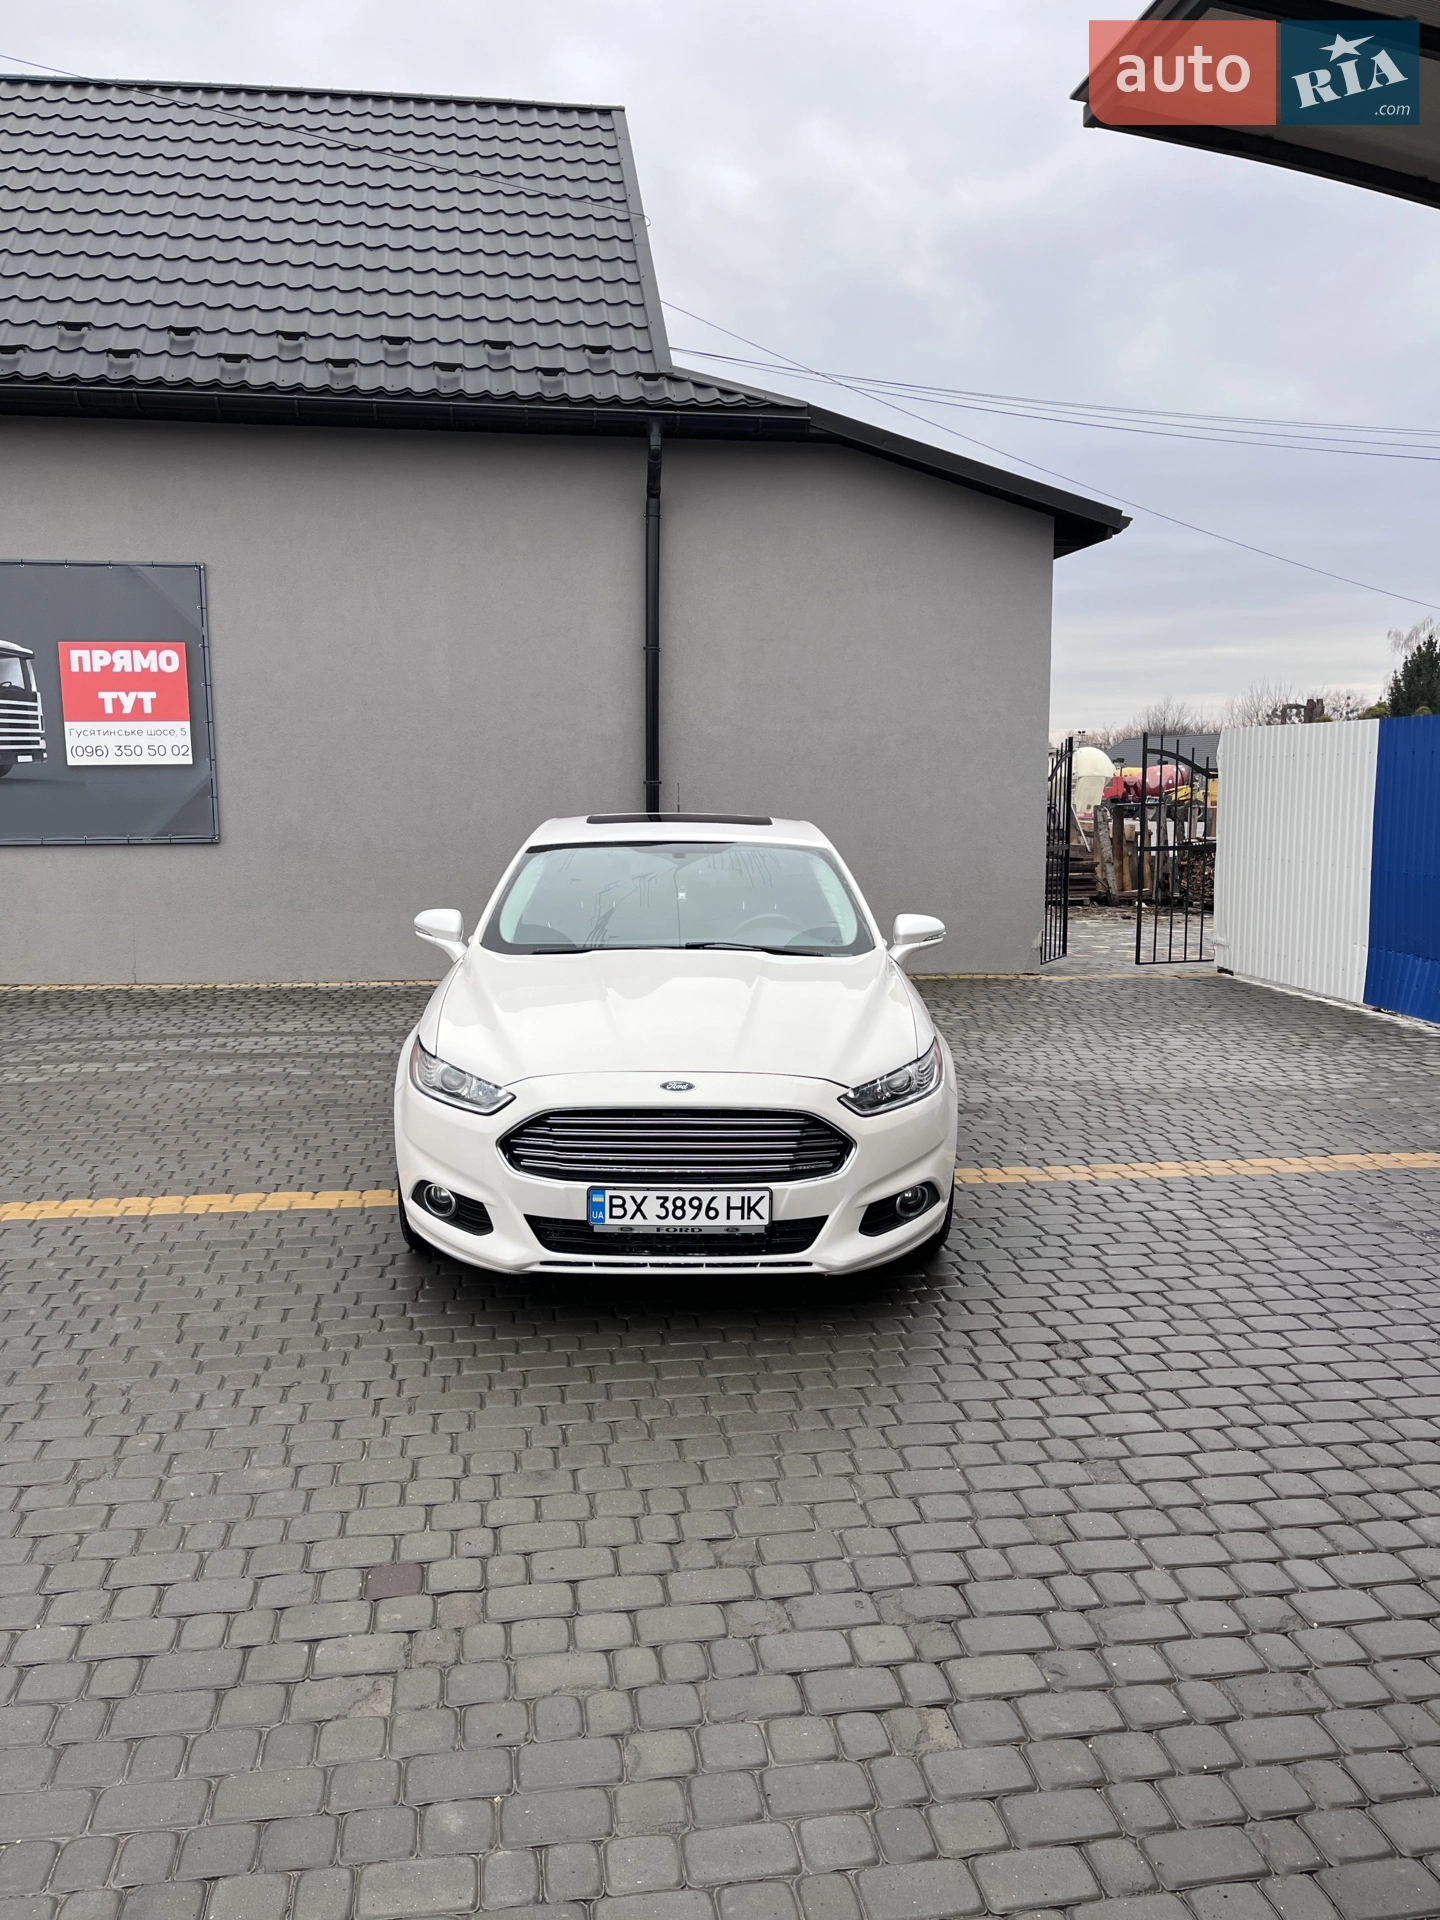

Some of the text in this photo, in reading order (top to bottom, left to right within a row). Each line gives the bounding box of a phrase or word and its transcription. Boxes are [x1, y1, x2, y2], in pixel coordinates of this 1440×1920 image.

[69, 649, 180, 673] ПРЯМО
[98, 691, 157, 714] ТУТ
[69, 727, 187, 738] Гусятинське шосе, 5
[70, 744, 190, 758] (096) 350 50 02
[666, 1081, 689, 1090] Ford
[592, 1211, 604, 1219] UA
[608, 1195, 766, 1221] BX 3896 HK
